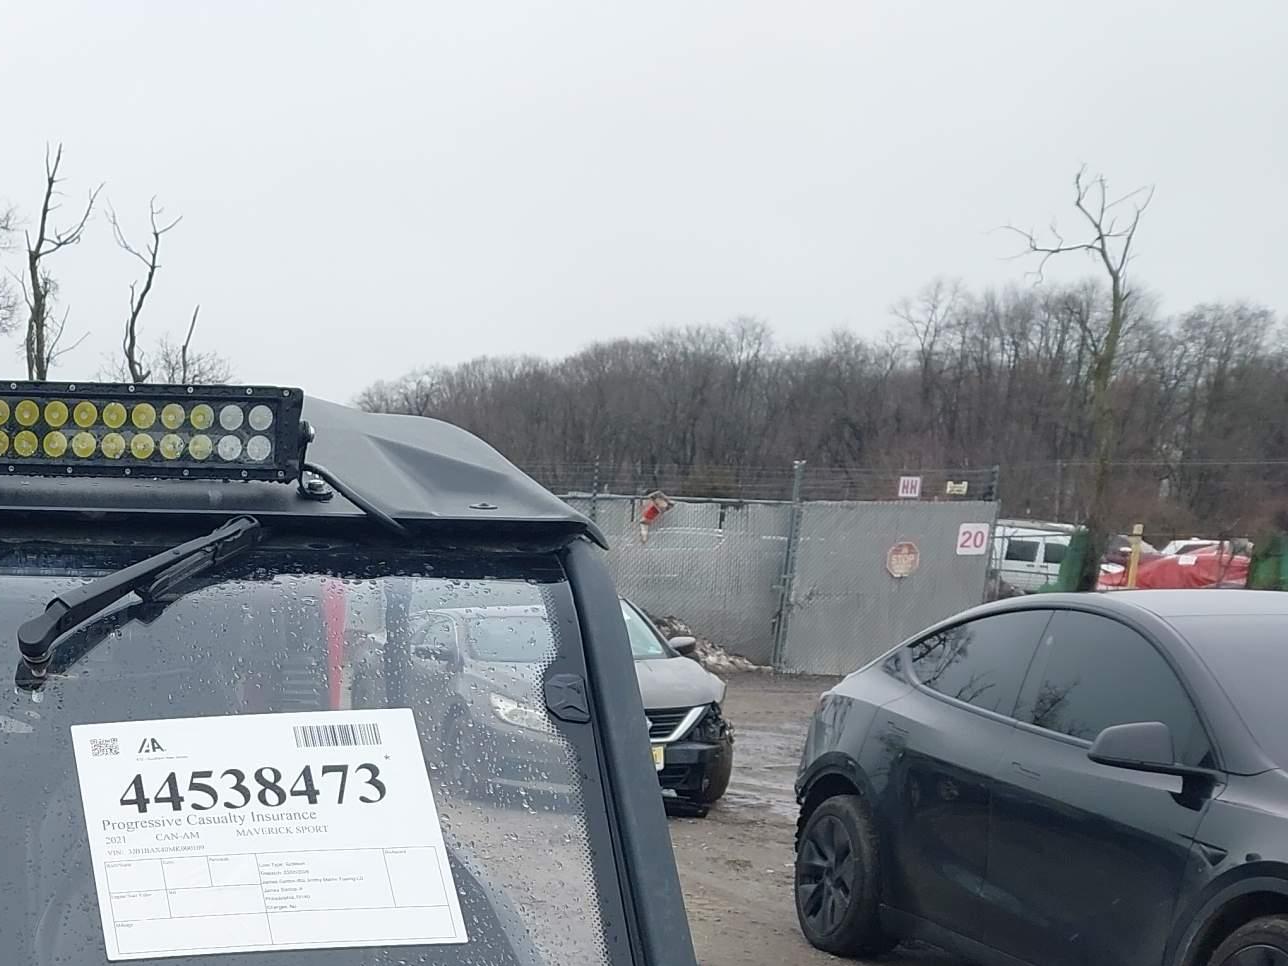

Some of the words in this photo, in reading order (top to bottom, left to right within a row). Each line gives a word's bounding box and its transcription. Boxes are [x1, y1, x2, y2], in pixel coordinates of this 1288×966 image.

[901, 479, 918, 494] HH
[959, 530, 985, 549] 20
[119, 762, 387, 814] 44538473
[101, 815, 182, 833] Progressive
[186, 811, 246, 827] Casualty
[251, 808, 318, 823] Insurance
[105, 835, 127, 845] 2021
[155, 831, 201, 842] CAN-AM
[235, 826, 294, 838] MAVERICK
[295, 824, 330, 835] SPORT
